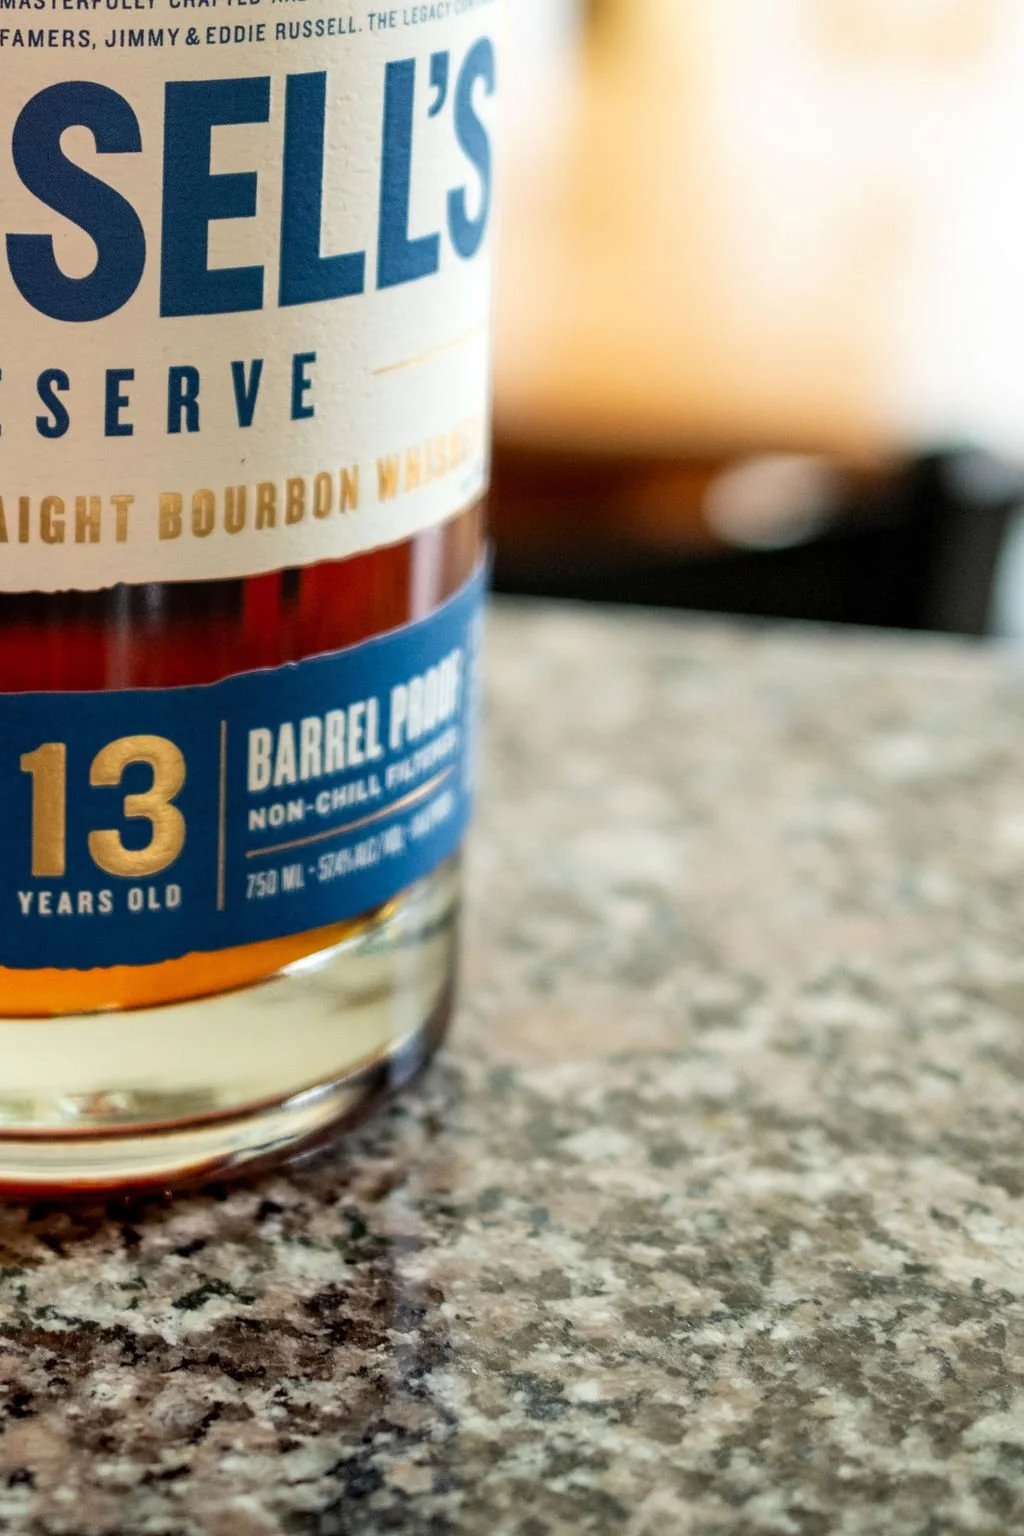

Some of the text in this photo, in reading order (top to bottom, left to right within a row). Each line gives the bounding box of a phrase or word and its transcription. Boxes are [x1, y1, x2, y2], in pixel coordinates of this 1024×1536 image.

[0, 28, 96, 50] FAMERS,
[105, 28, 180, 48] JIMMY
[185, 27, 200, 45] &
[206, 23, 266, 45] EDDIE
[275, 16, 363, 40] RUSSELL.
[368, 10, 397, 31] THE
[159, 464, 360, 542] BOURBON
[247, 696, 383, 792] BARREL
[19, 734, 187, 878] 13
[248, 774, 381, 832] NON-CHILL
[17, 884, 182, 916] YEARS OLD
[246, 868, 278, 899] 750
